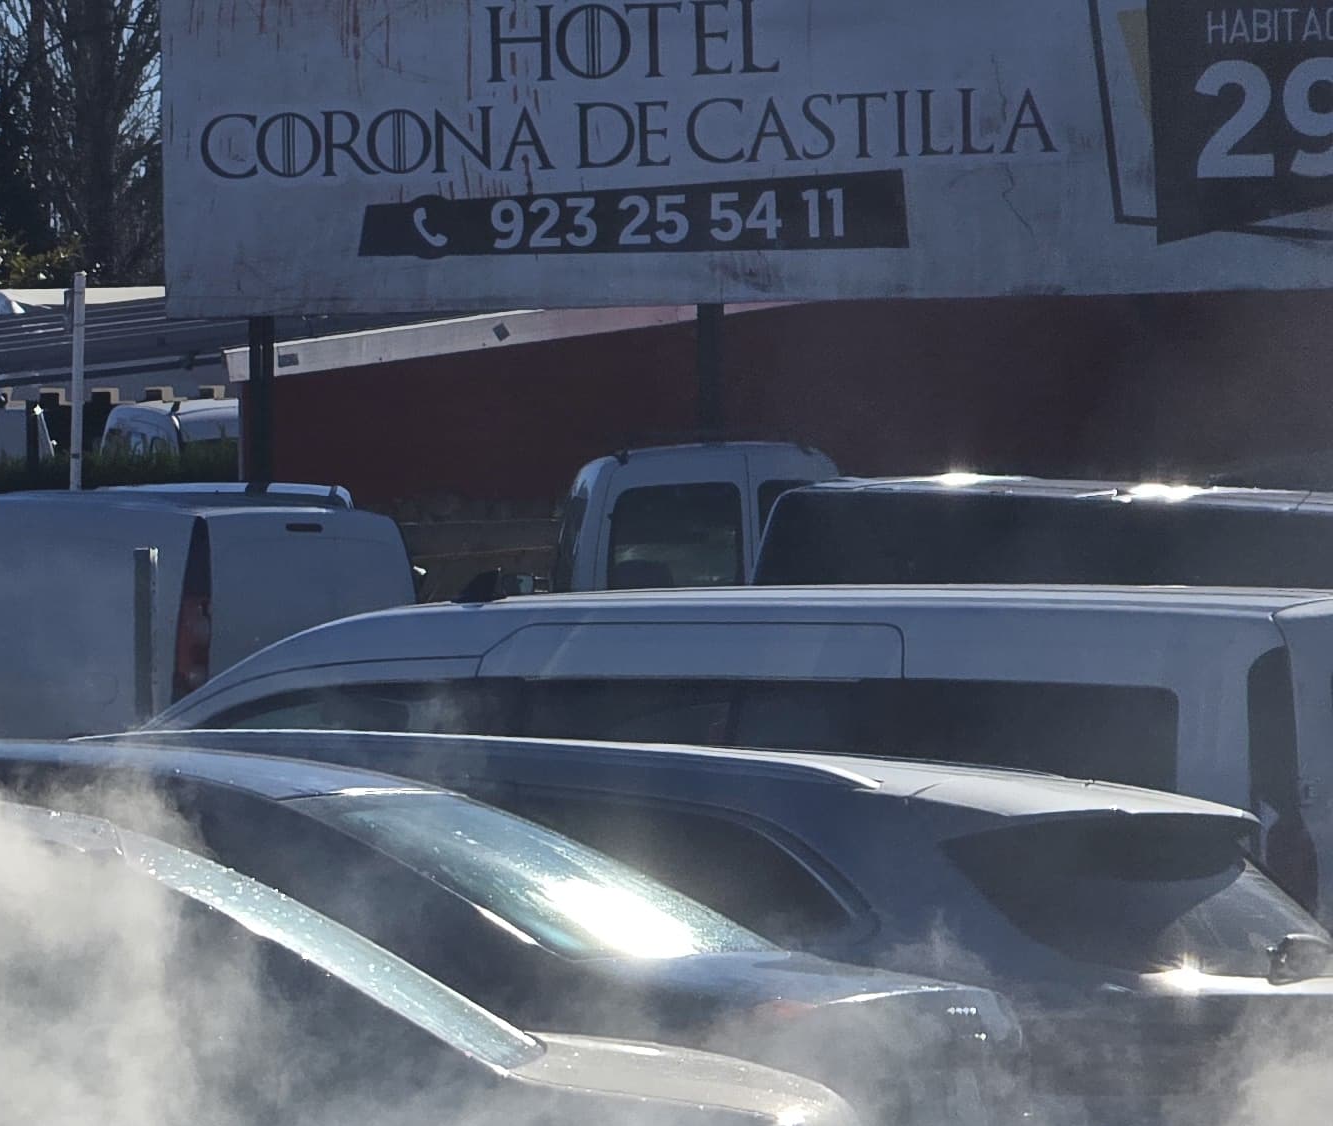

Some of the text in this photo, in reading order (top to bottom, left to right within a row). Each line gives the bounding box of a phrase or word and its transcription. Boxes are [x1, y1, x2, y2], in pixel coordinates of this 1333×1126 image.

[486, 0, 780, 83] HOTEL
[200, 87, 1059, 179] CORONA DE CASTILLA
[1194, 56, 1333, 179] 29
[490, 187, 845, 249] 923 25 54 11
